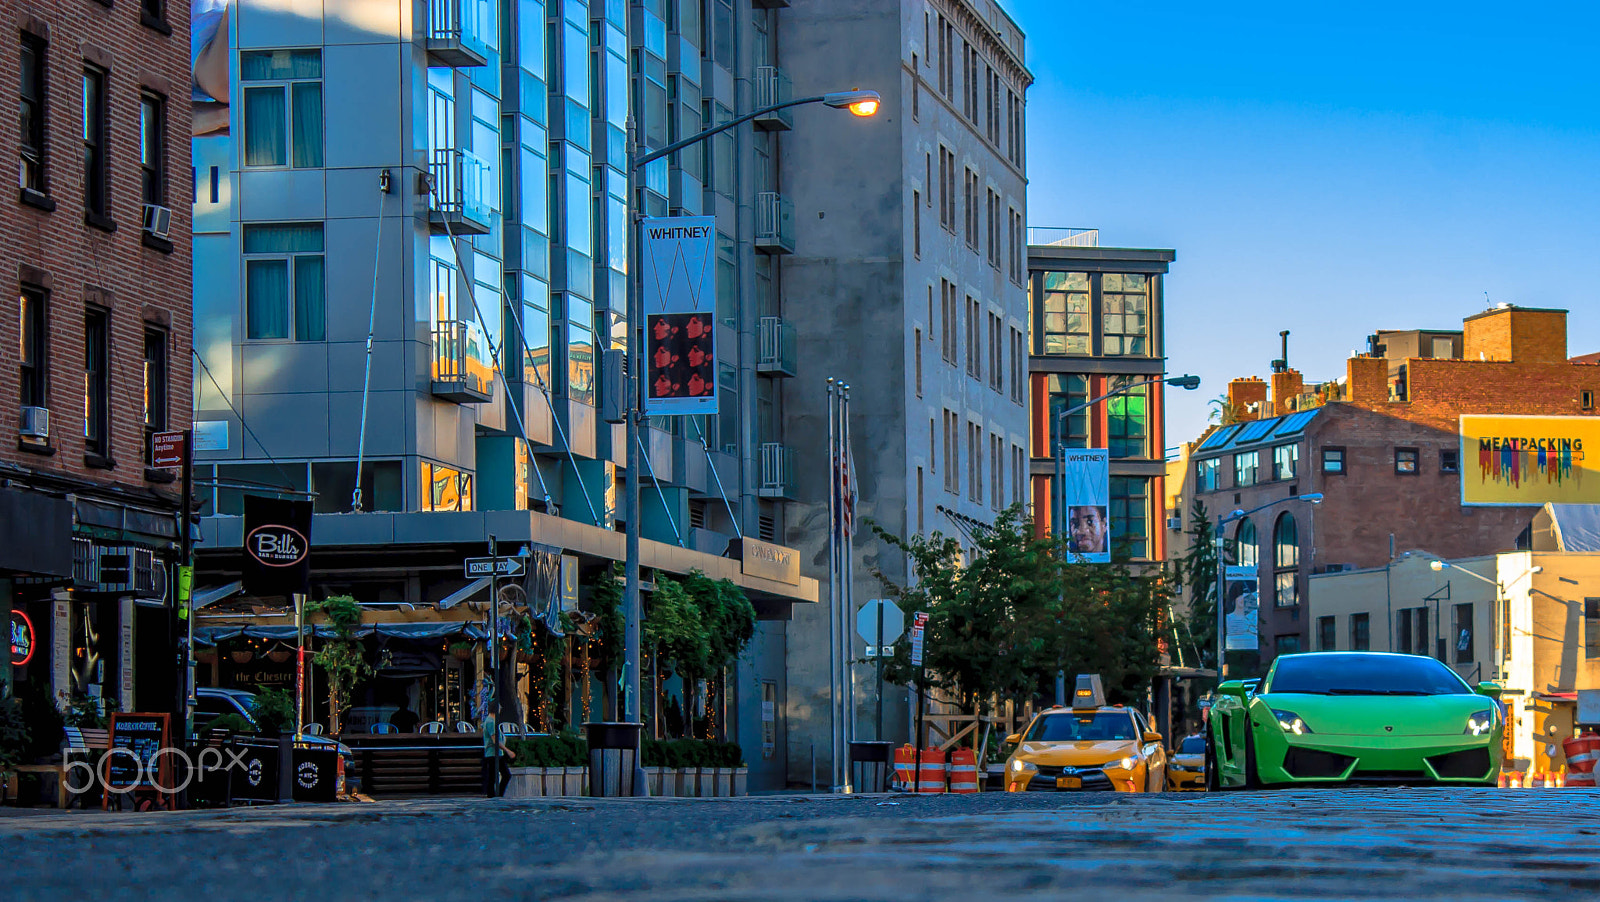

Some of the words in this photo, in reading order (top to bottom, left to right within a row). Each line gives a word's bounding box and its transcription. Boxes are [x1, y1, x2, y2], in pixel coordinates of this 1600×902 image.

[649, 226, 710, 240] WHITNEY
[154, 436, 162, 444] NO
[1479, 437, 1583, 452] MEATPACKING
[155, 444, 175, 452] Anytime
[1069, 454, 1105, 462] WHITNEY
[254, 533, 300, 555] Bill's
[254, 671, 292, 682] Chester
